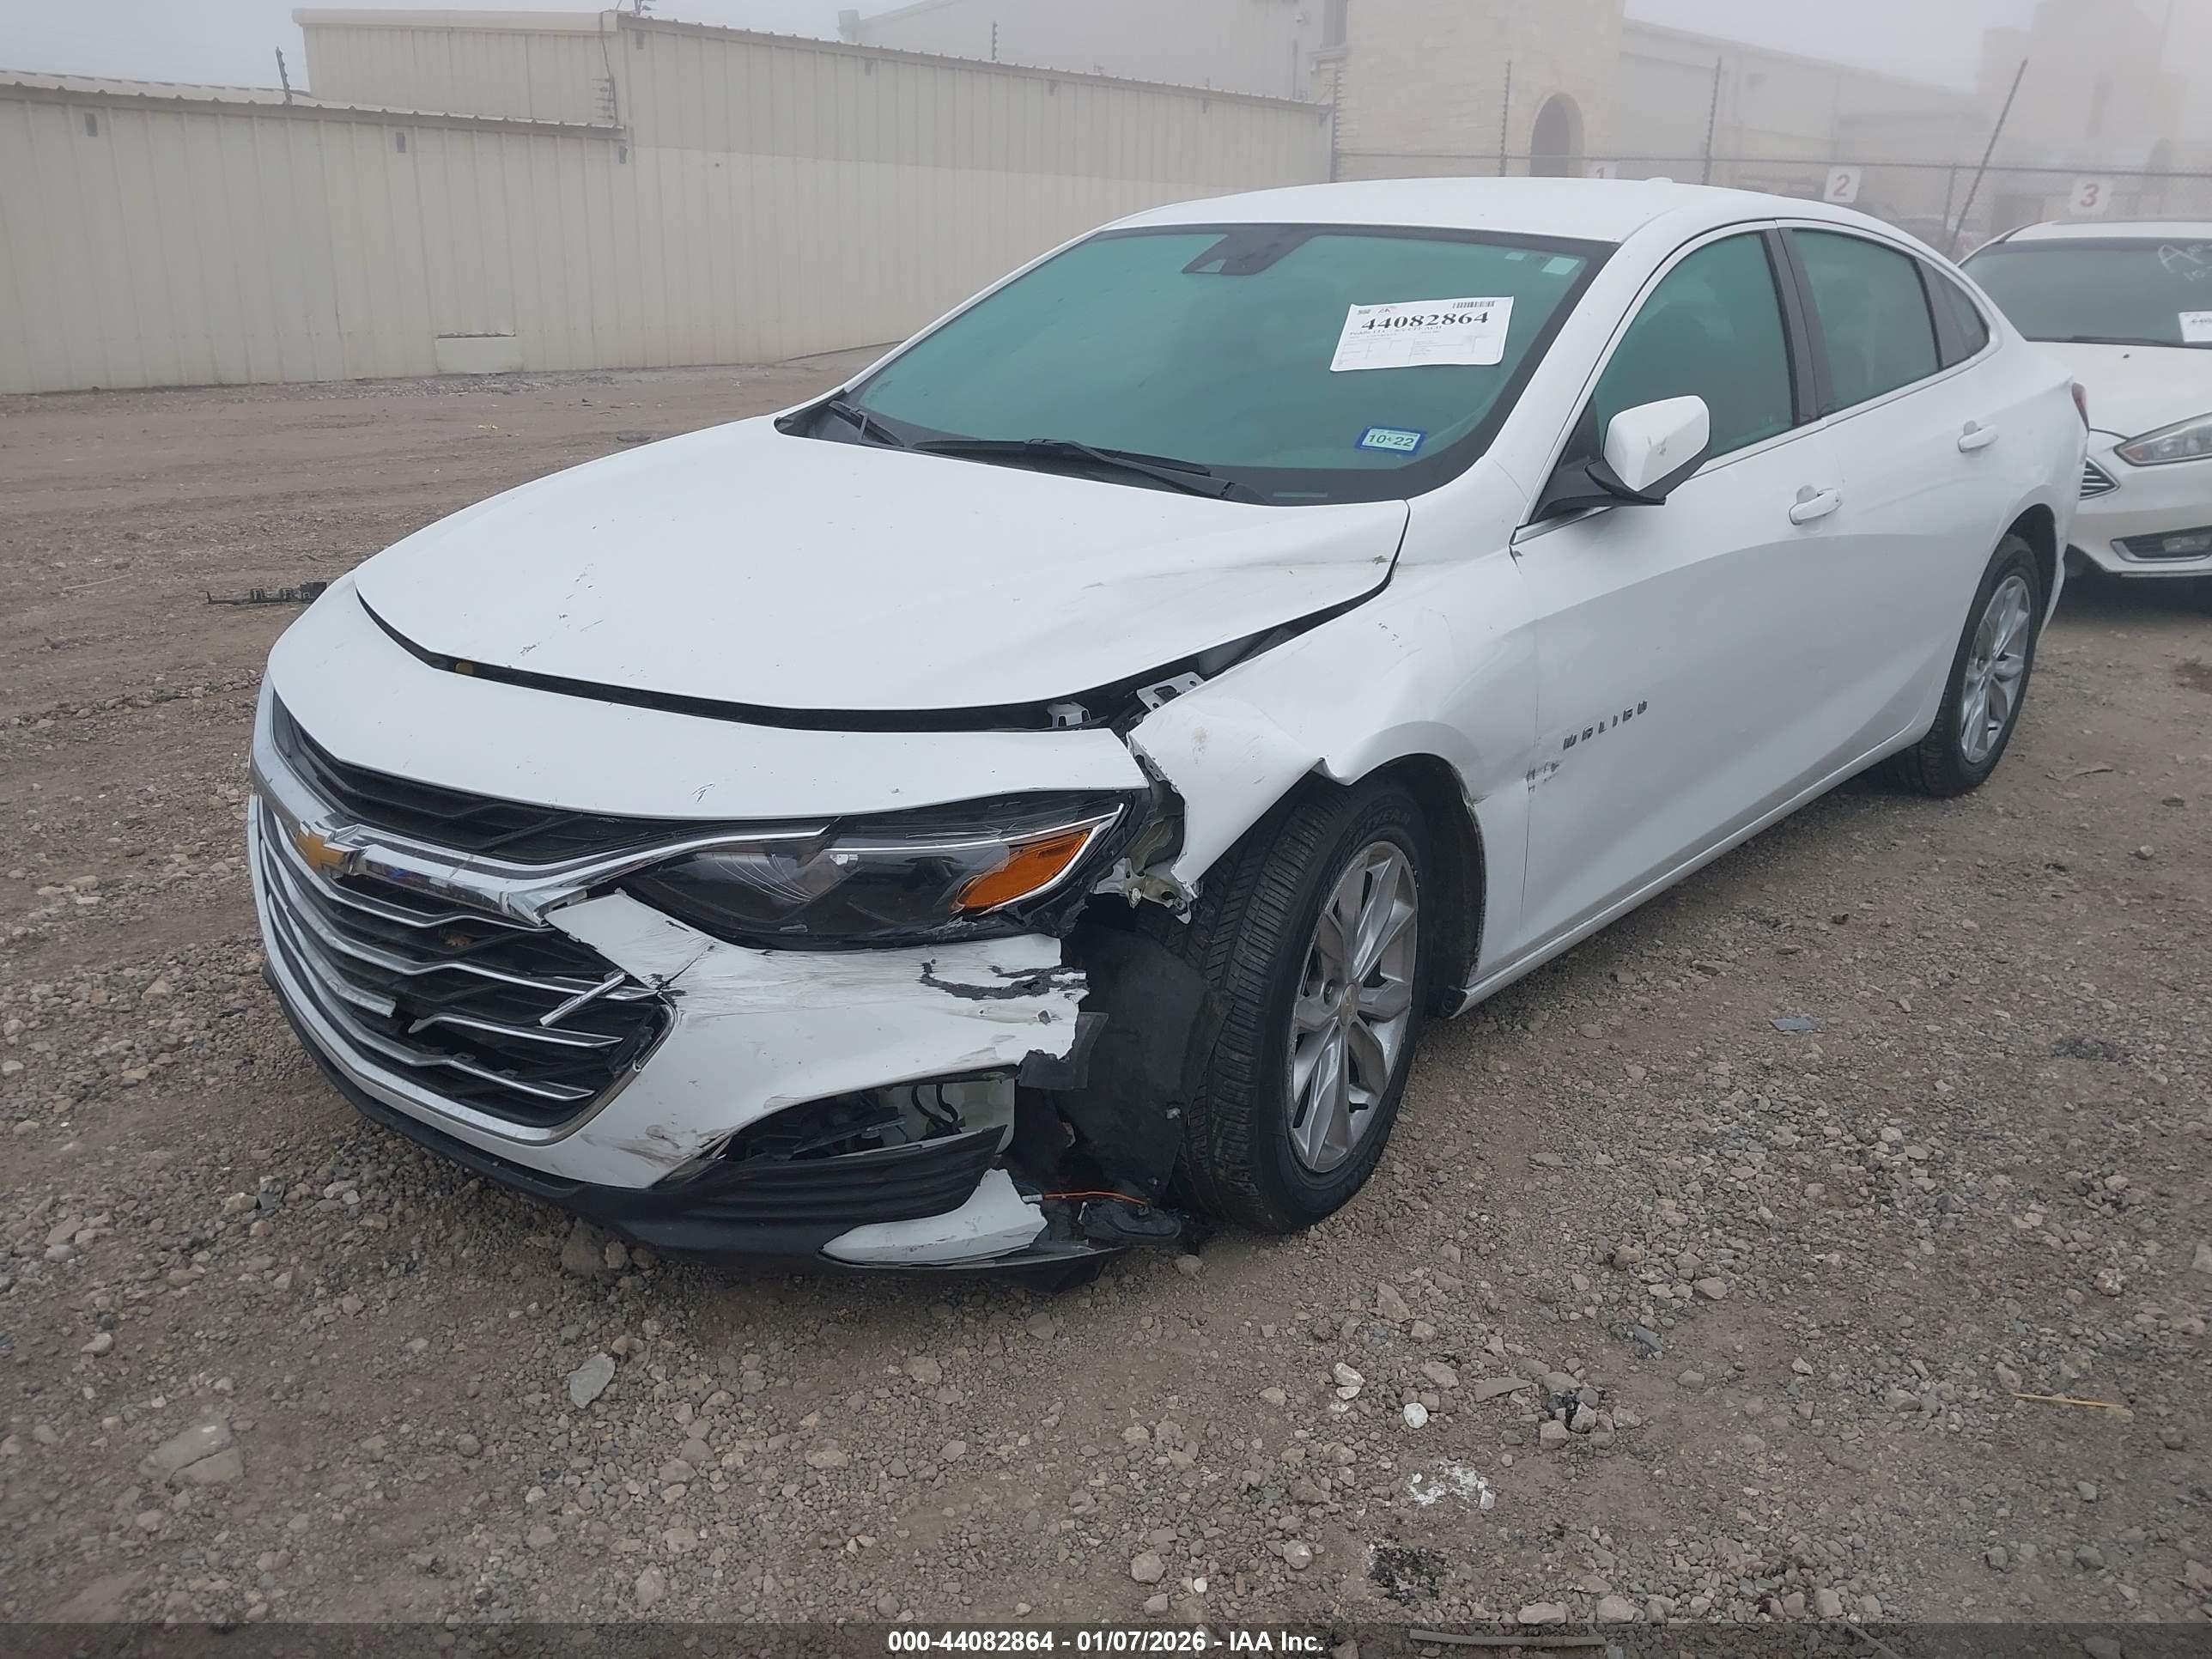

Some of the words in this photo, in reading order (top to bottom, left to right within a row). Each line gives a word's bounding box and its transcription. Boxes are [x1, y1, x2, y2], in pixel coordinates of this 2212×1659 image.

[1833, 173, 1850, 197] 2
[2079, 183, 2100, 207] 3
[1361, 311, 1490, 331] 44082864
[1563, 699, 1648, 750] MALIBU
